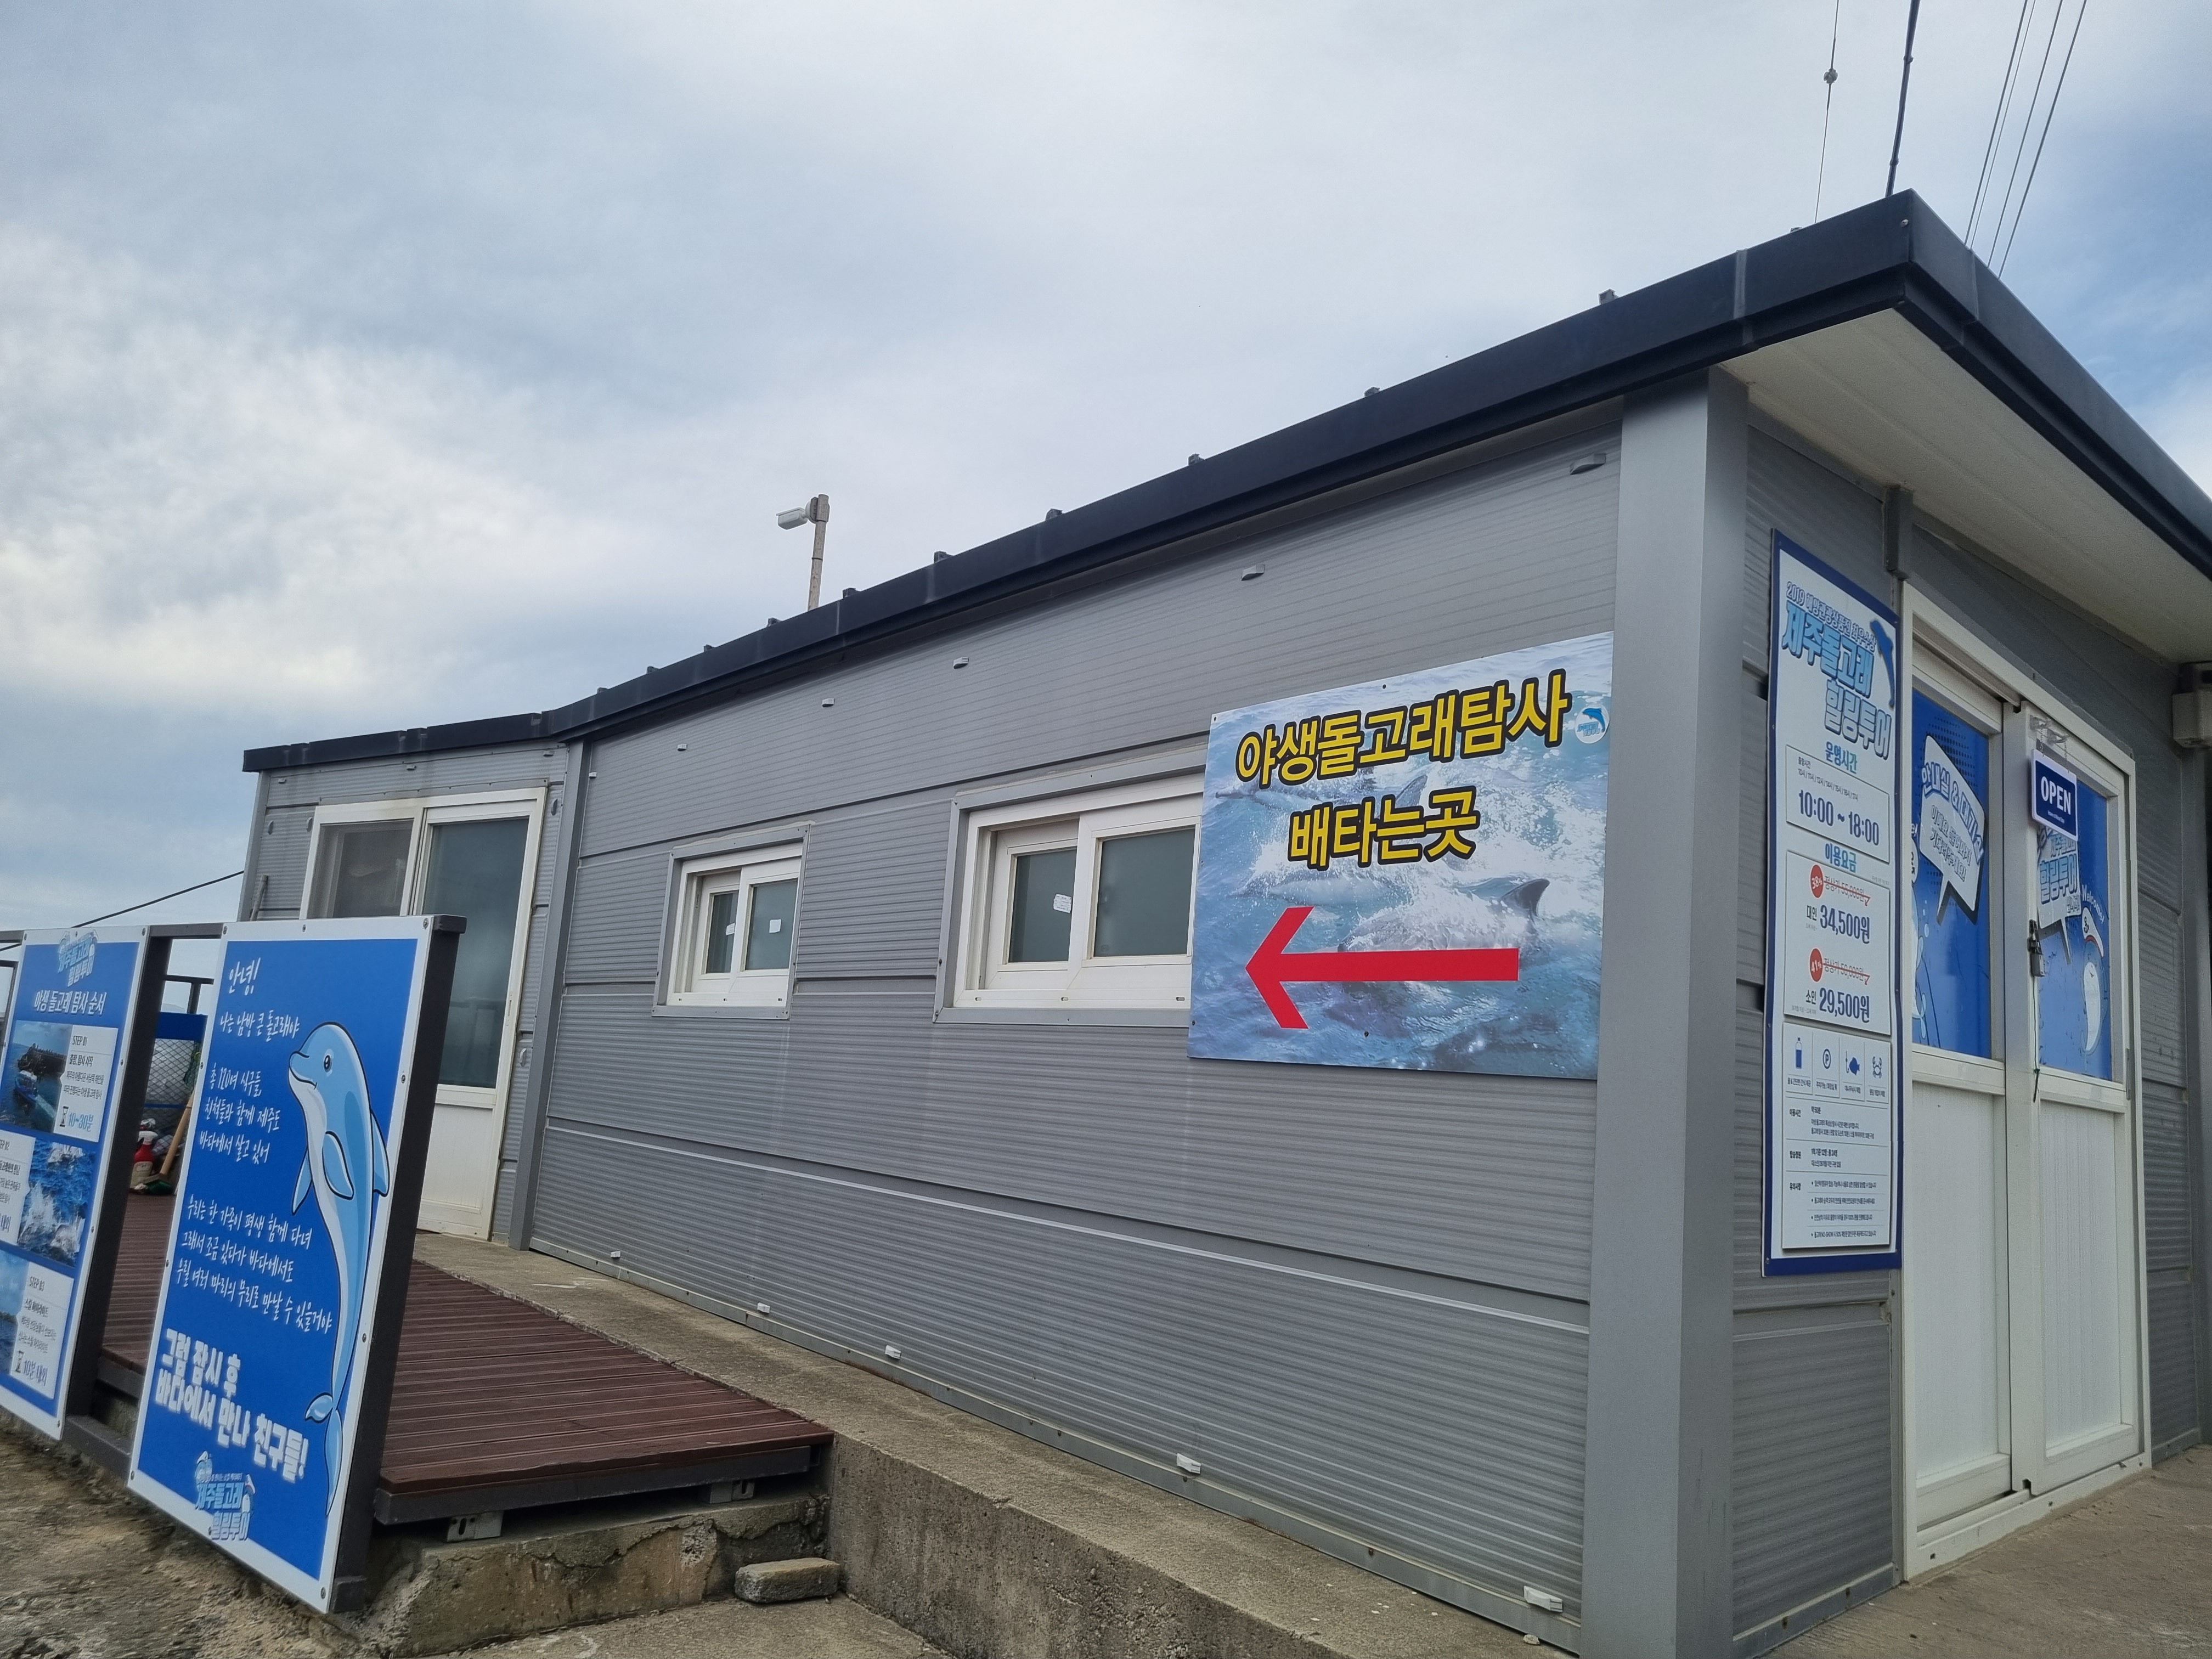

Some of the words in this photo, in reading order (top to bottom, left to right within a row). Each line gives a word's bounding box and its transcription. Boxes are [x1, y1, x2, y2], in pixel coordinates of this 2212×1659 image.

[1786, 581, 1805, 606] 2019
[1852, 622, 1876, 652] 최우수상
[1782, 600, 1875, 699] 제주돌고래
[1237, 669, 1572, 789] 야생돌고래탐사
[1825, 679, 1892, 760] 힐링투어
[1825, 742, 1857, 774] 운영시간
[1922, 761, 1950, 802] 안내실
[1951, 781, 1960, 812] &
[2041, 776, 2071, 815] OPEN
[1288, 785, 1481, 871] 배타는곳
[1799, 789, 1833, 826] 10:00
[1837, 813, 1845, 822] ~
[1848, 811, 1879, 846] 18:00
[1825, 843, 1857, 873] 이용요금
[1812, 876, 1822, 889] 38%
[2040, 853, 2078, 905] 힐링투어
[2081, 884, 2105, 924] Welcome!
[1807, 905, 1817, 922] 대인
[1820, 904, 1870, 944] 34,500원
[67, 955, 95, 988] 힐링투어
[229, 957, 261, 995] 안녕!
[1811, 960, 1822, 973] 41%
[34, 990, 50, 1013] 야생
[48, 990, 73, 1013] 돌고래
[71, 991, 89, 1014] 탐사
[88, 991, 108, 1015] 순서
[1805, 989, 1817, 1005] 소인
[1819, 987, 1870, 1023] 29,500원
[72, 1035, 83, 1046] STEP
[82, 1036, 88, 1046] 01
[220, 1012, 234, 1034] 나는
[237, 1012, 255, 1037] 남방
[257, 1013, 264, 1036] 큰
[266, 1010, 301, 1042] 돌고래야
[85, 1056, 94, 1067] 시작
[210, 1062, 217, 1090] 총
[218, 1067, 239, 1090] 120여
[240, 1070, 262, 1097] 식구들,
[68, 1112, 94, 1132] 10~30분
[205, 1097, 234, 1125] 친척들과
[237, 1099, 256, 1126] 함께
[257, 1106, 281, 1133] 제주도
[200, 1130, 233, 1155] 바다에서
[235, 1134, 250, 1162] 살고
[253, 1139, 270, 1164] 있어
[188, 1194, 206, 1220] 우리는
[209, 1199, 218, 1224] 한
[221, 1206, 242, 1231] 가족이
[245, 1212, 264, 1238] 평생
[268, 1213, 289, 1242] 함께
[291, 1224, 312, 1250] 다녀
[182, 1230, 205, 1254] 그래서
[221, 1240, 246, 1266] 있다가
[250, 1249, 294, 1283] 바다에서도
[29, 1276, 40, 1289] STEP
[177, 1258, 191, 1288] 우릴
[191, 1267, 209, 1290] 여러
[211, 1273, 236, 1302] 마리의
[238, 1279, 259, 1308] 무리로
[263, 1290, 283, 1321] 만날
[285, 1296, 294, 1324] 수
[296, 1301, 332, 1334] 있을거야
[24, 1359, 36, 1380] 10분
[162, 1328, 191, 1374] 그럼
[193, 1340, 223, 1387] 잠시
[224, 1353, 241, 1398] 후
[156, 1368, 216, 1430] 바다에서
[217, 1396, 251, 1448] 만나
[254, 1413, 309, 1484] 친구들!
[194, 1481, 245, 1510] 제주돌고래
[211, 1511, 251, 1541] 힐링투어
